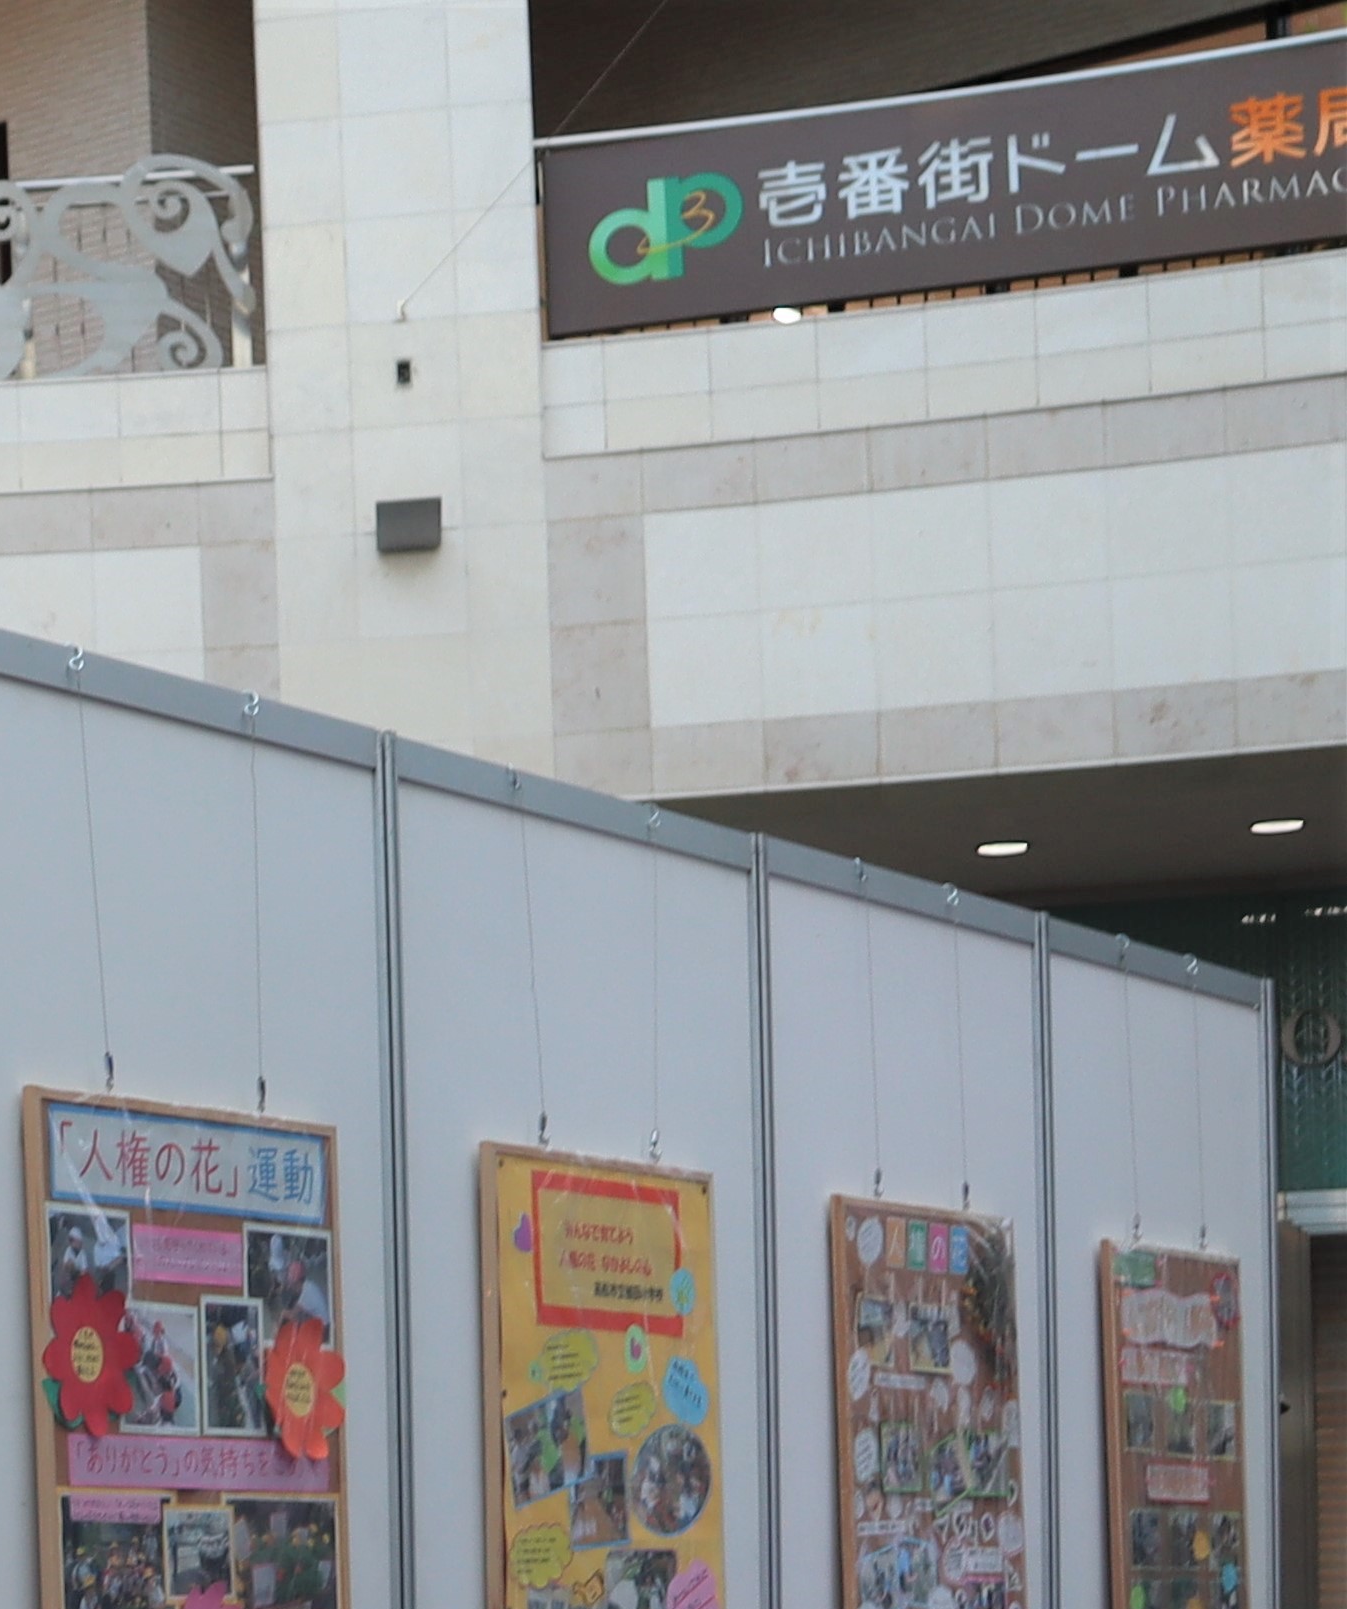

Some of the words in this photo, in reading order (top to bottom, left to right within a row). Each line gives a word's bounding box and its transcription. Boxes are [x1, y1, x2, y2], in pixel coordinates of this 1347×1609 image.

[763, 214, 997, 269] ICHIBANGAI
[1015, 194, 1136, 236] DOME
[59, 1120, 315, 1206] 「人権の花」運動
